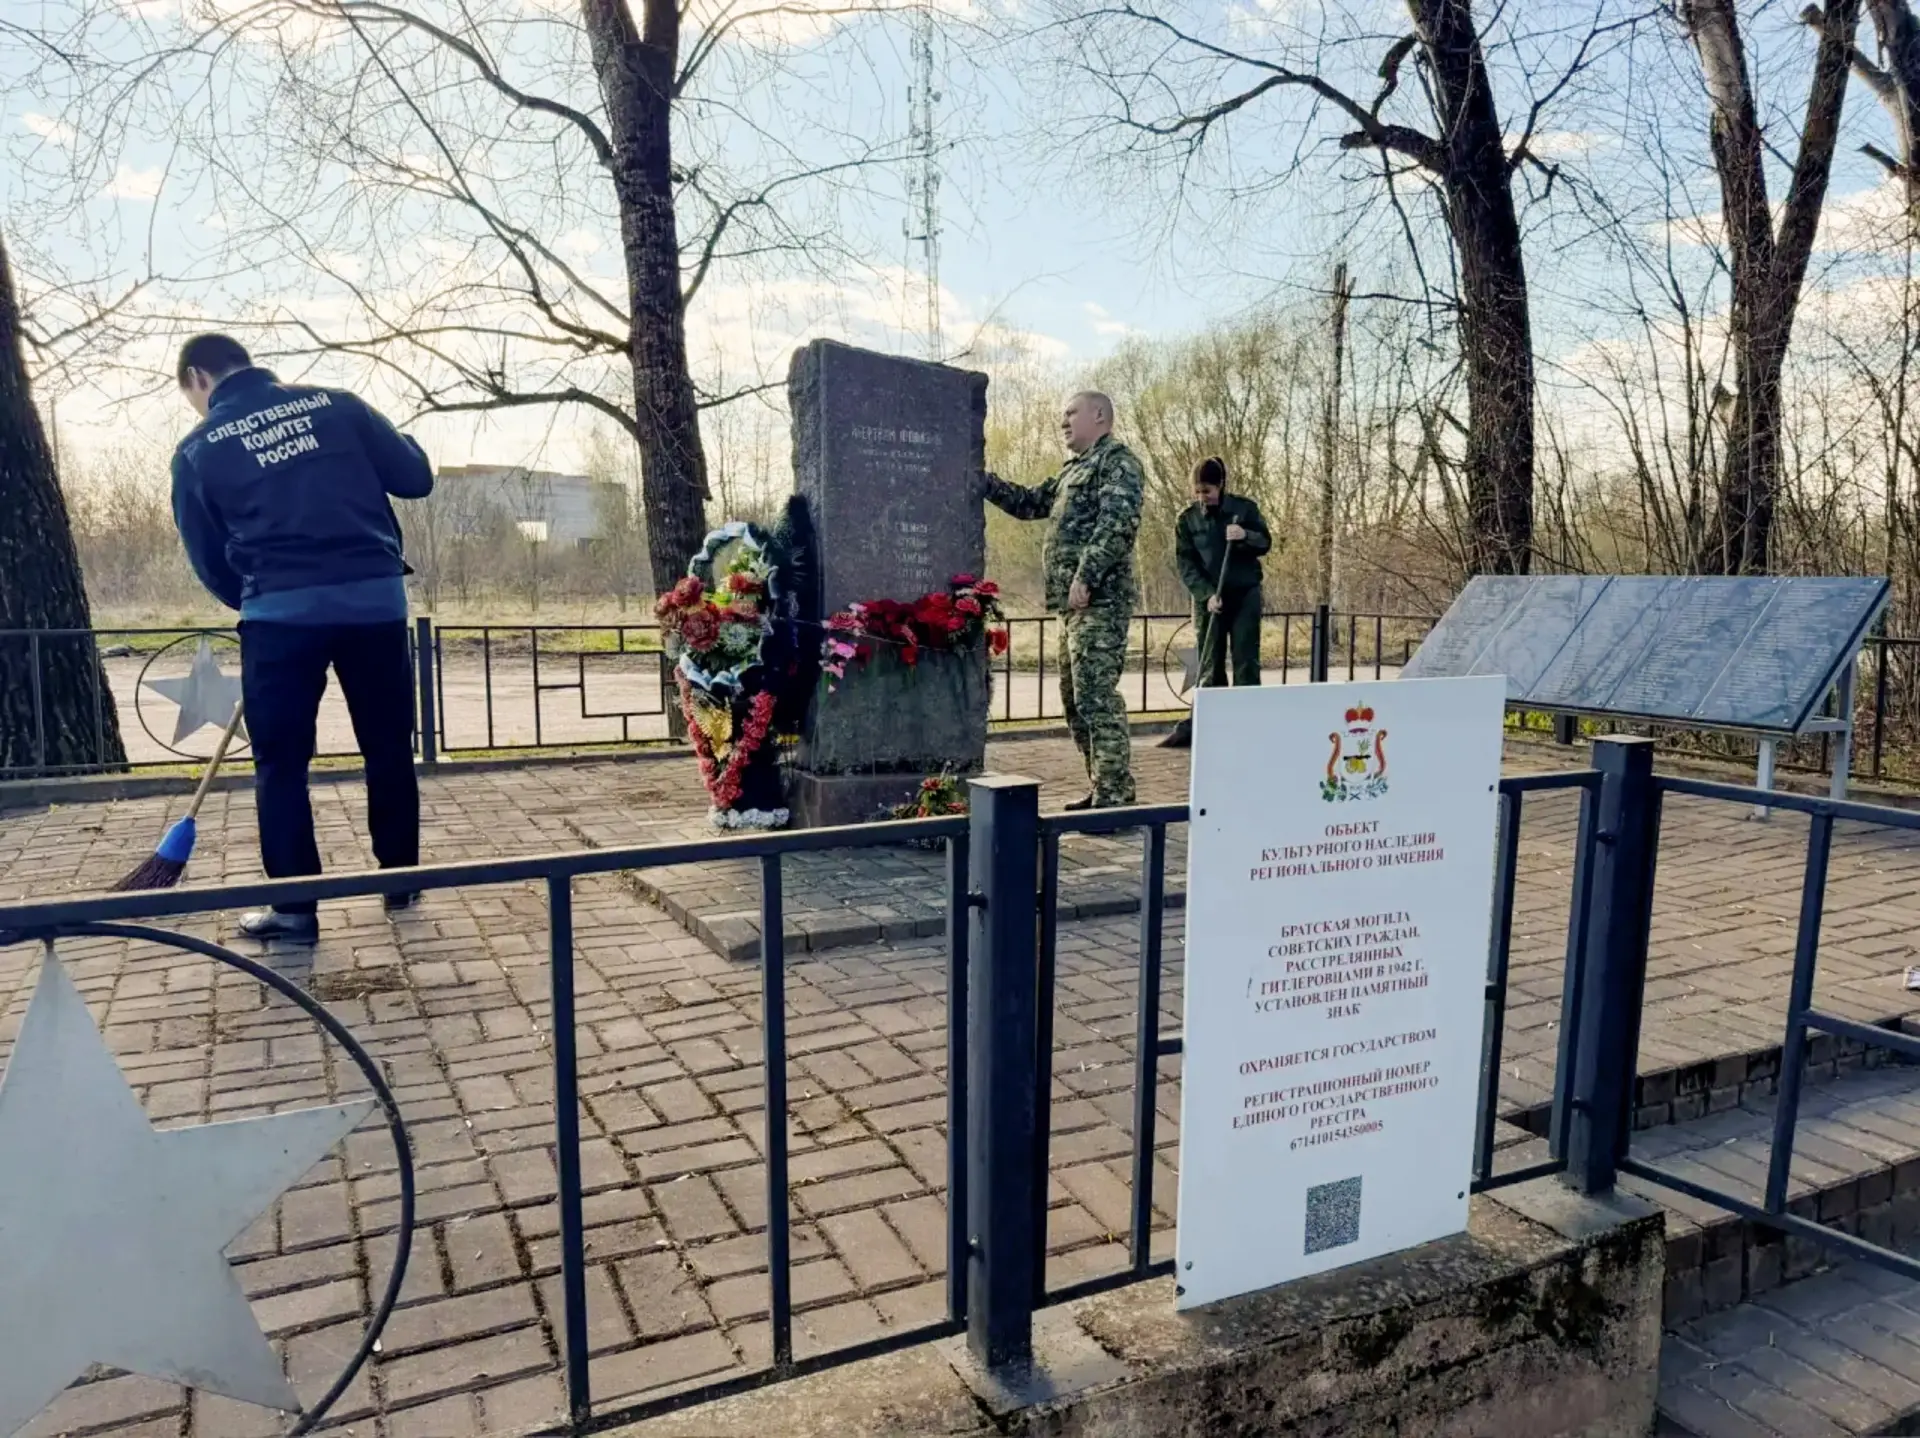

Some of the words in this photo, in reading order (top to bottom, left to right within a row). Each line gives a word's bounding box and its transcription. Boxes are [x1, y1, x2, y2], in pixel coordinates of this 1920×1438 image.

[207, 392, 332, 443] СЛЕДСТВЕННЫЙ
[241, 415, 313, 451] КОМИТЕТ
[256, 434, 319, 468] РОССИИ
[1325, 821, 1379, 836] ОБЪЕКТ
[1261, 840, 1361, 861] КУЛЬТУРНОГО
[1365, 832, 1435, 850] НАСЛЕДИЯ
[1251, 857, 1373, 881] РЕГИОНАЛЬНОГО
[1378, 848, 1443, 867] ЗНАЧЕНИЯ
[1281, 918, 1350, 938] БРАТСКАЯ
[1355, 912, 1410, 928] МОГИЛА
[1268, 936, 1351, 958] СОВЕТСКИХ
[1287, 946, 1402, 972] РАССТРЕЛЯННЫХ
[1255, 989, 1347, 1013] УСТАНОВЛЕН
[1351, 974, 1428, 998] ПАМЯТНЫЙ
[1261, 967, 1372, 995] ГИТЛЕРОВЦАМИ
[1377, 965, 1384, 976] В
[1389, 961, 1412, 974] 1942
[1327, 1003, 1361, 1019] ЗНАК
[1240, 1048, 1328, 1075] ОХРАНЯЕТСЯ
[1333, 1029, 1436, 1057] ГОСУДАРСТВОМ
[1245, 1068, 1382, 1108] РЕГИСТРАЦИОННЫЙ
[1386, 1061, 1430, 1080] НОМЕР
[1232, 1105, 1299, 1129] ЕДИНОГО
[1303, 1076, 1439, 1114] ГОСУДАРСТВЕННОГО
[1311, 1108, 1365, 1129] РЕЕСТРА
